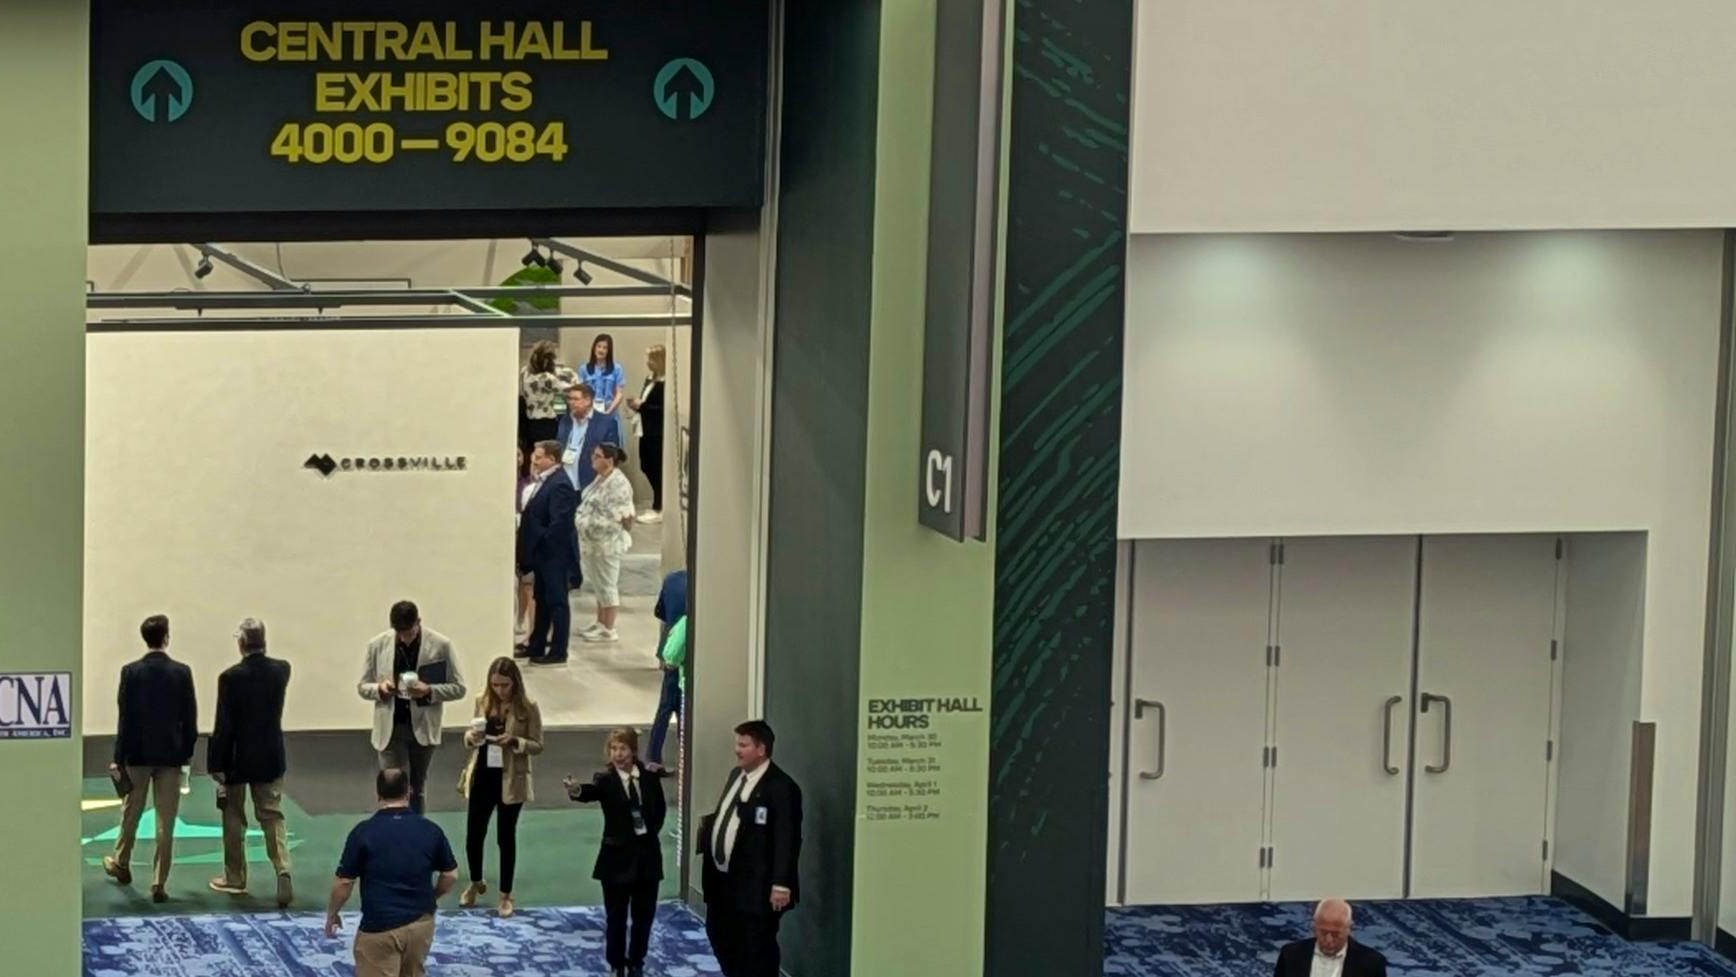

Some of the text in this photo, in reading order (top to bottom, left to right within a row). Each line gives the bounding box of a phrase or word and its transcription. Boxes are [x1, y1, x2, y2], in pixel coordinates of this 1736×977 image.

[239, 20, 609, 62] CENTRAL HALL
[315, 70, 533, 113] EXHIBITS
[339, 456, 468, 472] CROSSVILLE
[926, 449, 953, 514] C1
[868, 697, 983, 713] EXHIBIT HALL
[867, 715, 930, 729] HOURS
